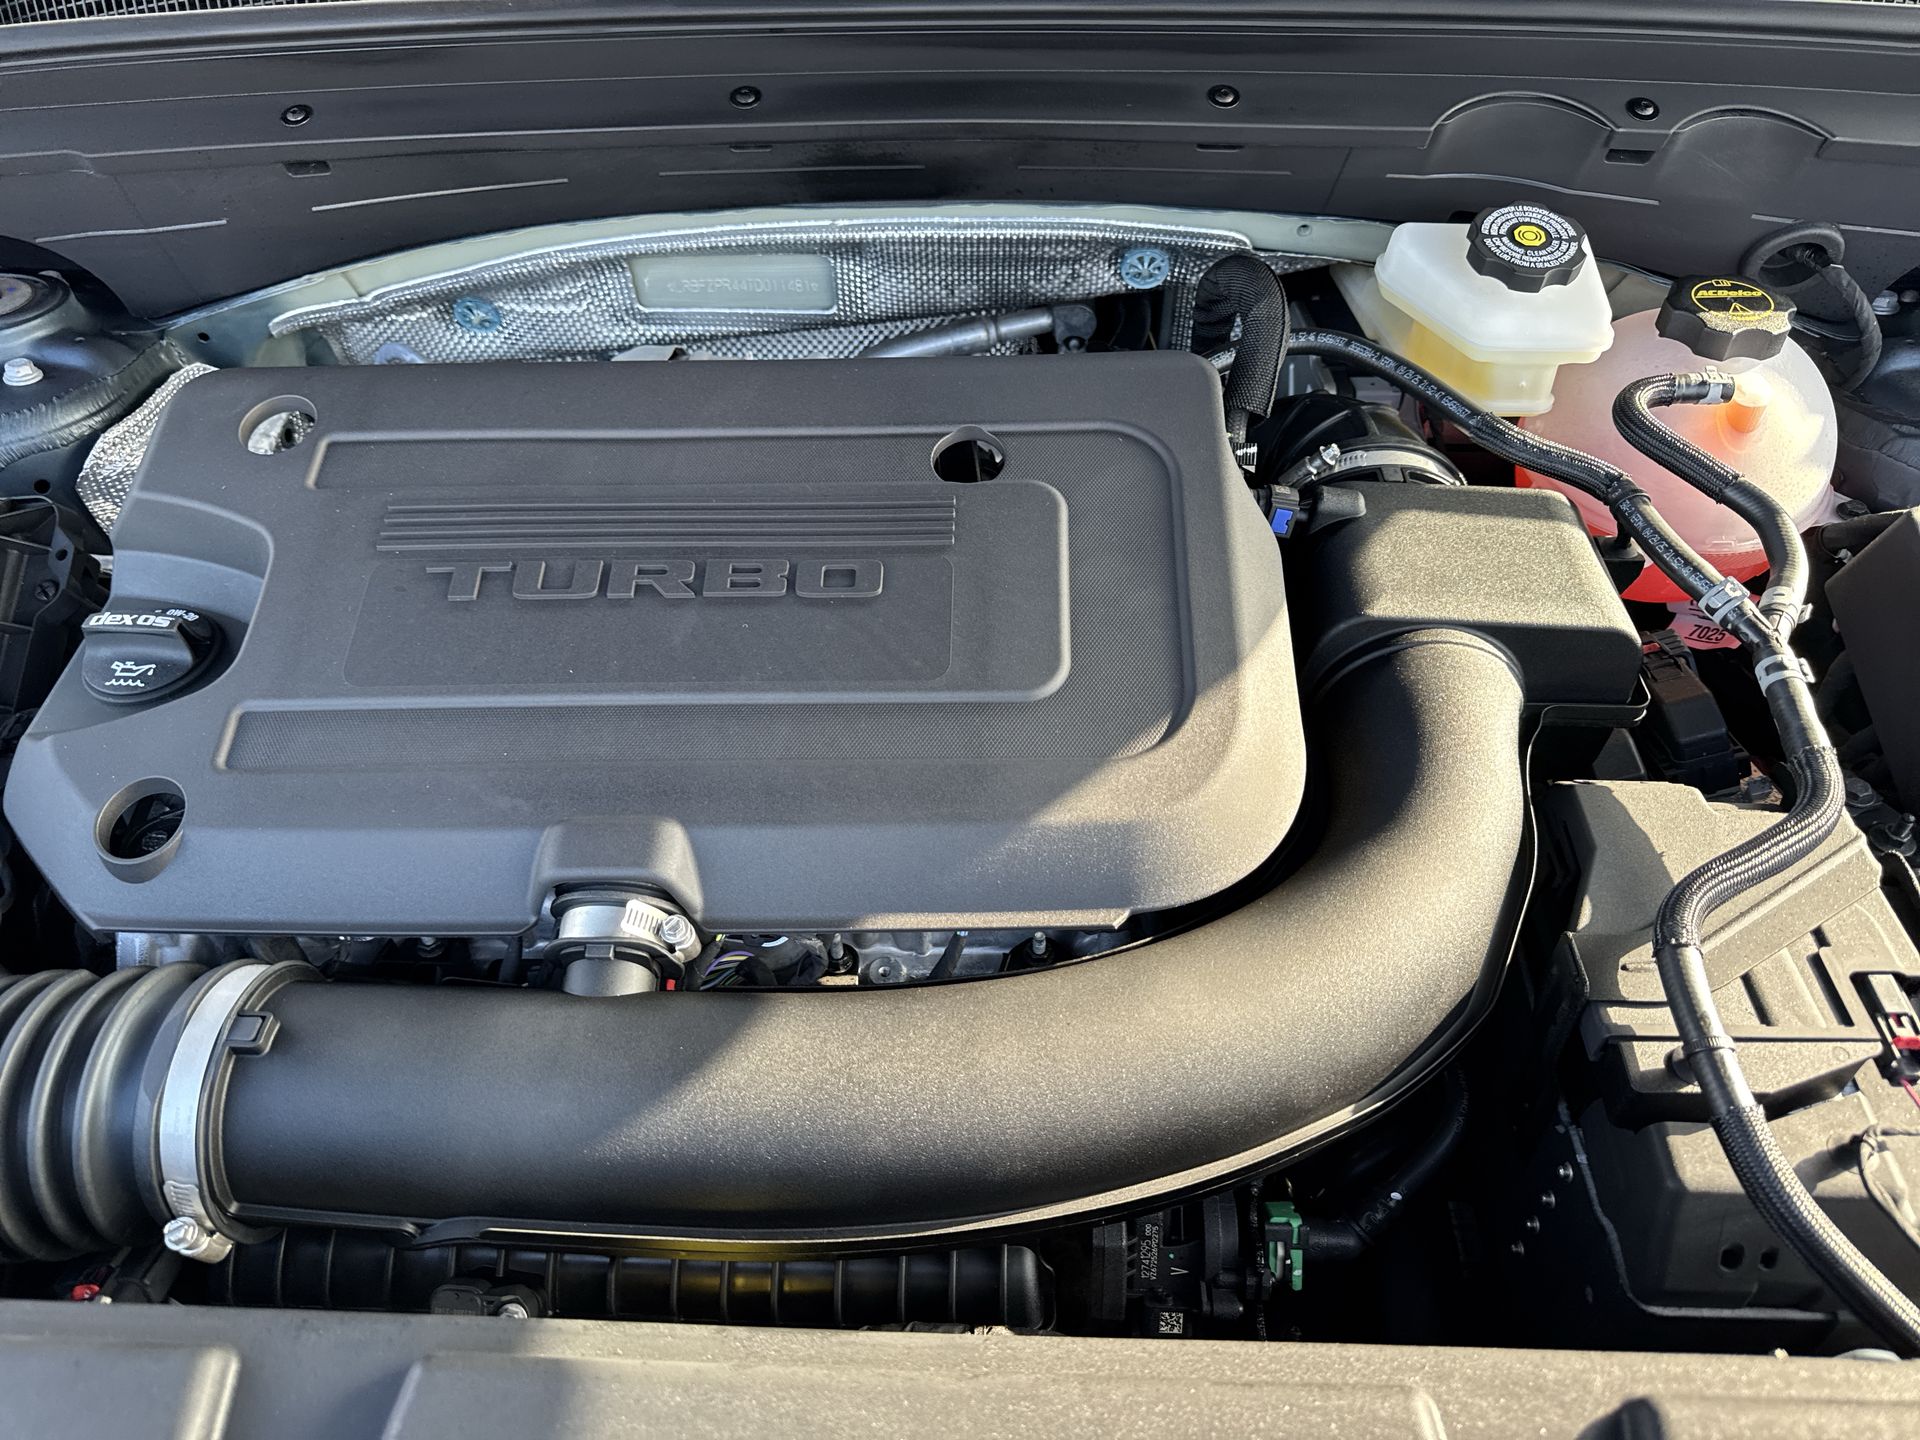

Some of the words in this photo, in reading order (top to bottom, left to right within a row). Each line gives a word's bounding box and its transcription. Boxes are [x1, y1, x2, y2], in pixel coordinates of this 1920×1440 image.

[1527, 249, 1548, 257] CLEAN
[1510, 258, 1530, 268] FROM
[1697, 289, 1762, 298] ACDelco
[426, 559, 884, 601] TURBO
[89, 611, 176, 628] dexos
[1688, 624, 1727, 642] 7025
